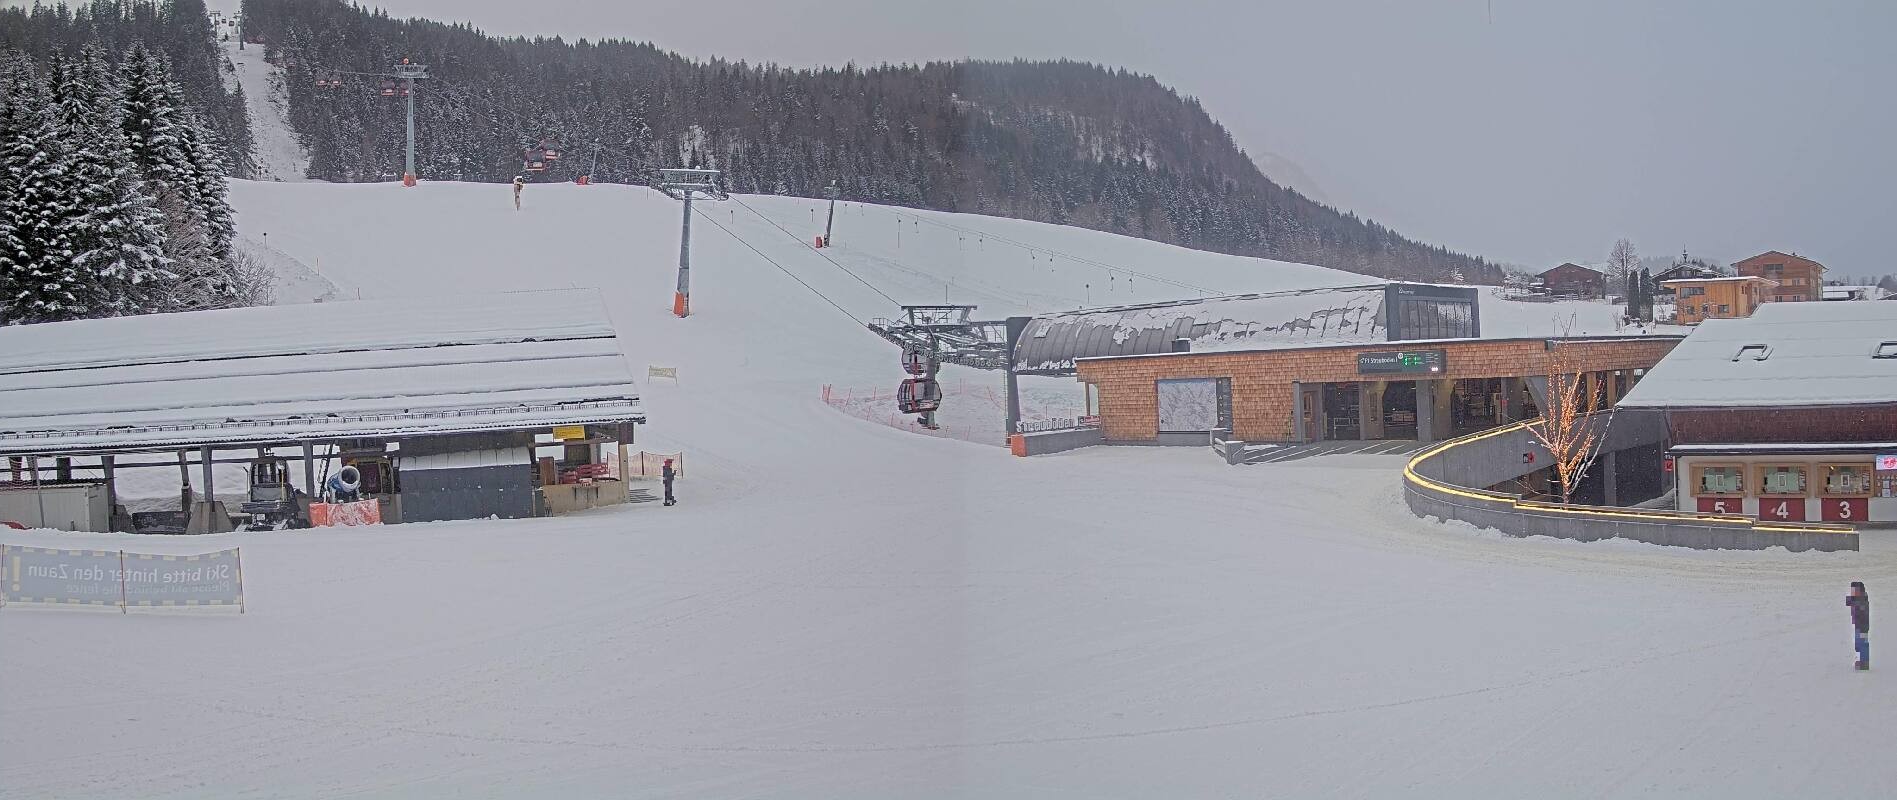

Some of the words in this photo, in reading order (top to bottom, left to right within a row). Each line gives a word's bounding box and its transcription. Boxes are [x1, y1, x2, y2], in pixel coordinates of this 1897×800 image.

[1714, 501, 1726, 514] 5
[1776, 501, 1789, 519] 4
[1839, 501, 1852, 519] 3
